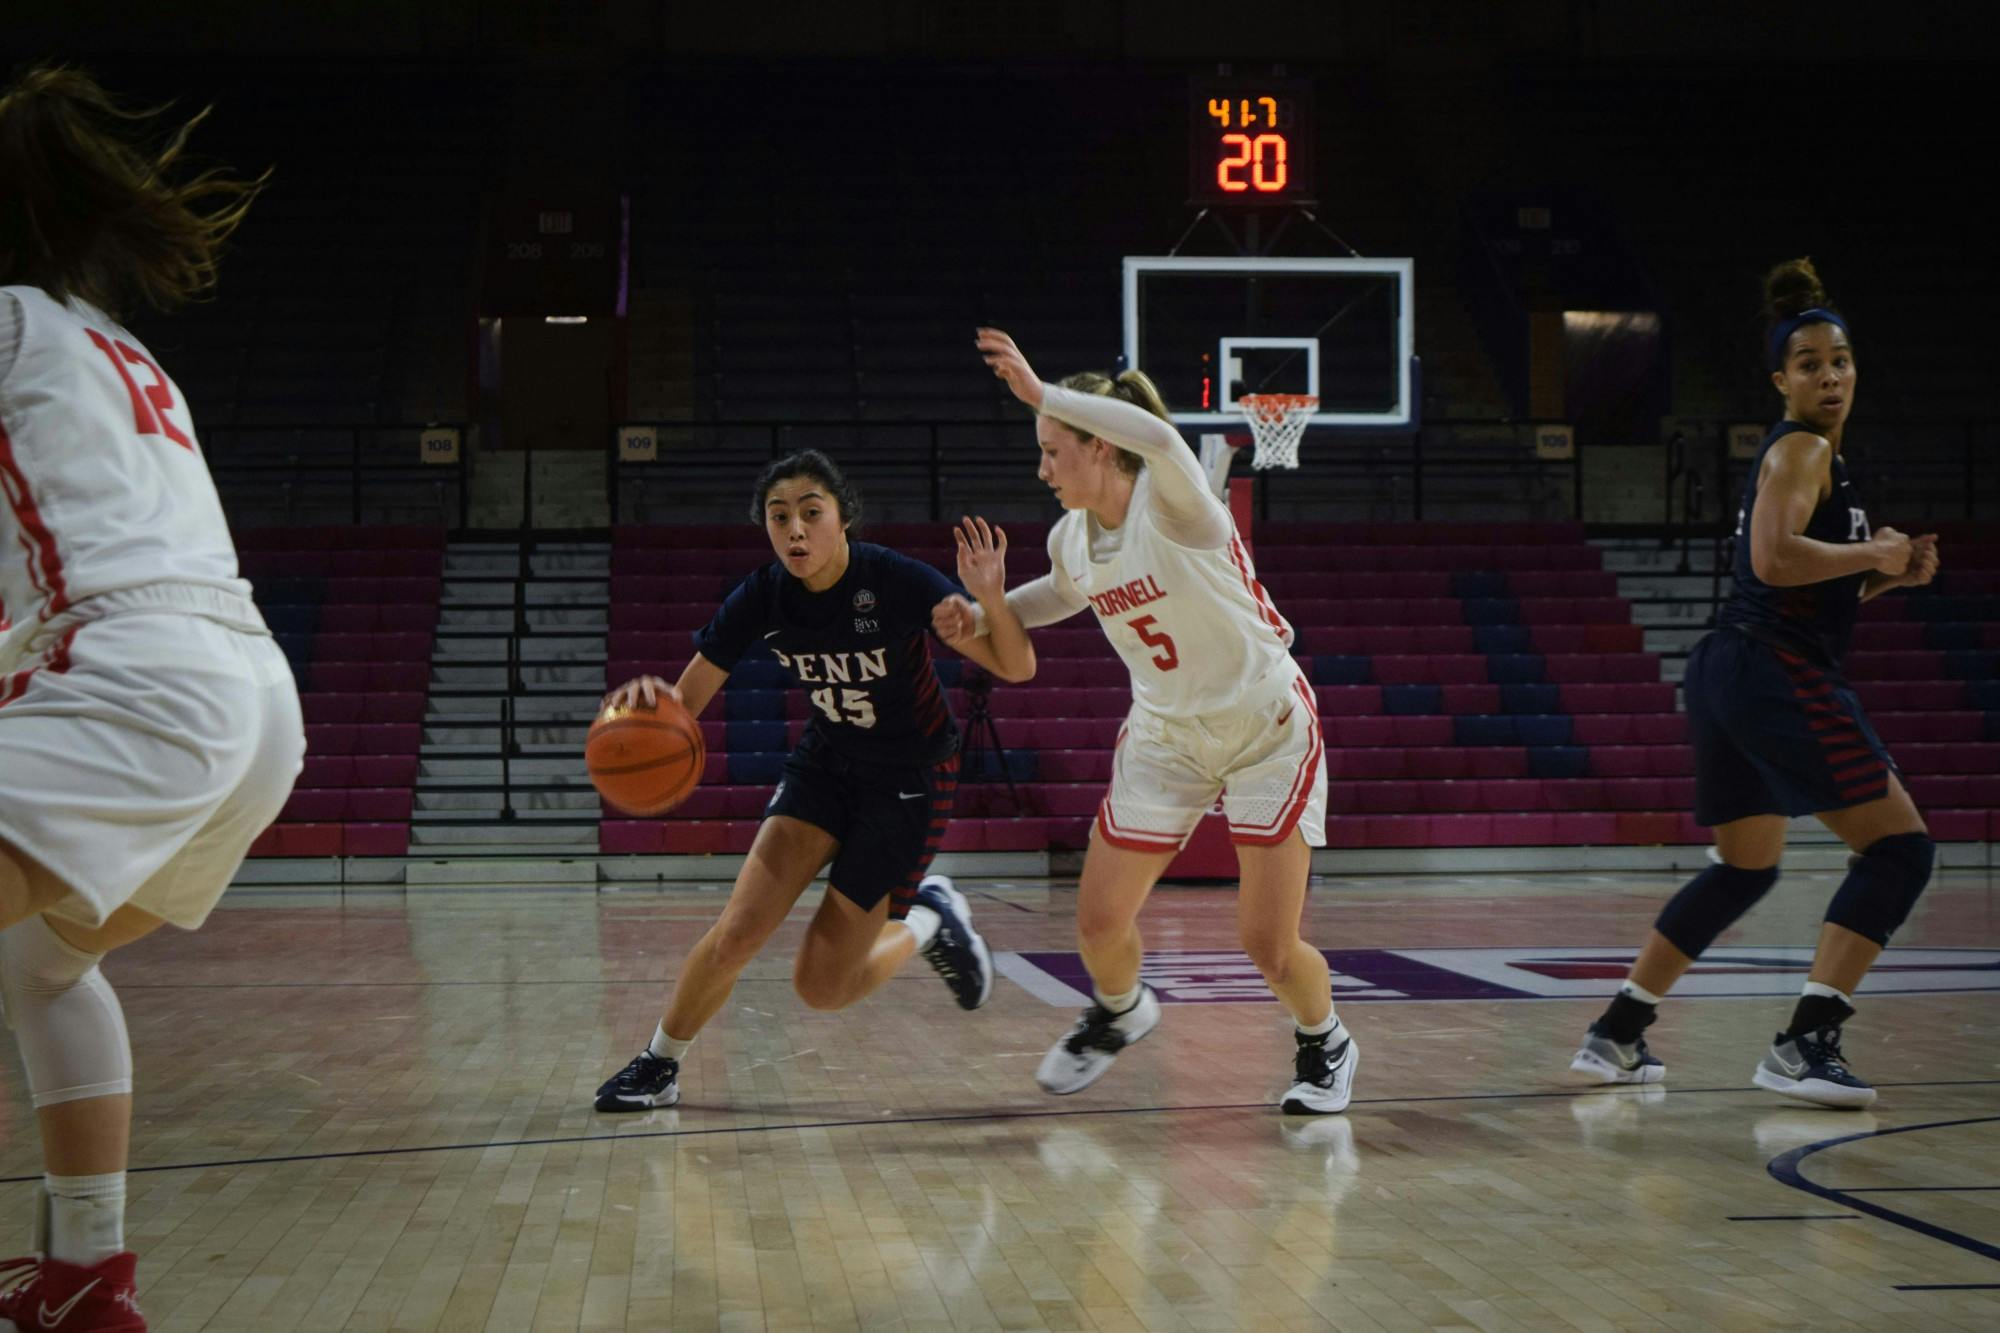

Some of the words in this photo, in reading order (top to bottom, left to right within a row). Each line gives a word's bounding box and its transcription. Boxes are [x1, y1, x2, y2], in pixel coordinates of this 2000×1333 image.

[1217, 133, 1288, 192] 20
[84, 327, 196, 452] 12
[427, 439, 452, 452] 108
[626, 437, 651, 449] 109
[1126, 613, 1179, 672] 5
[810, 686, 877, 729] 45
